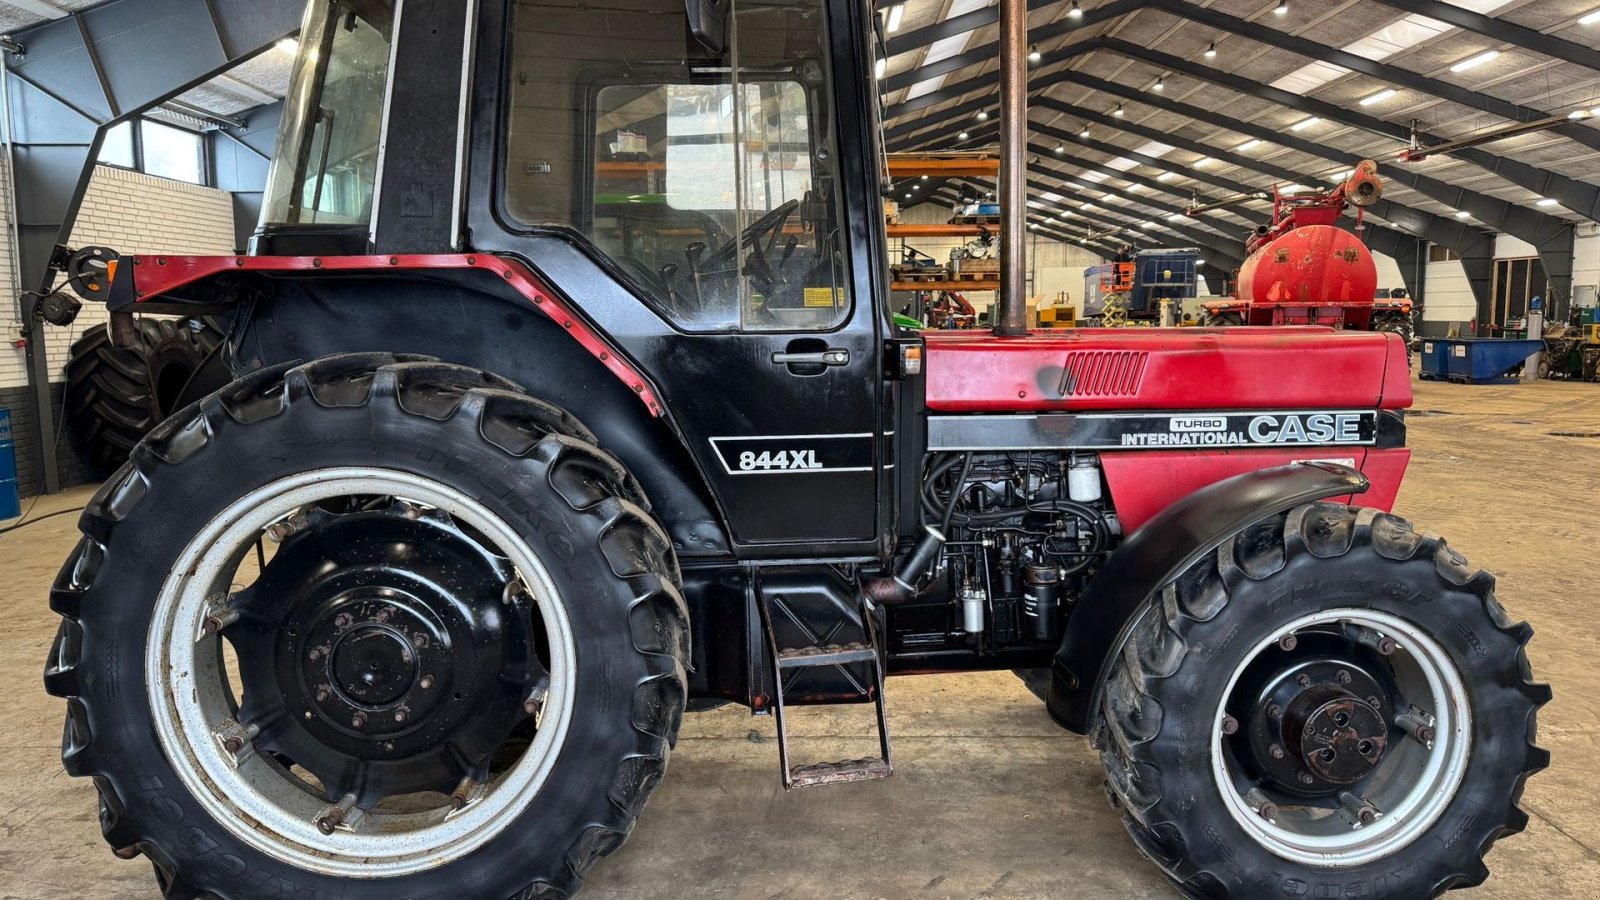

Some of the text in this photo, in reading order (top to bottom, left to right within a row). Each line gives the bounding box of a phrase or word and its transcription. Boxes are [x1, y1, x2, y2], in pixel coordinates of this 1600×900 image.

[1121, 414, 1361, 446] INTERNATIONAL CASE
[1175, 419, 1222, 428] TURBO
[739, 450, 823, 470] 844XL
